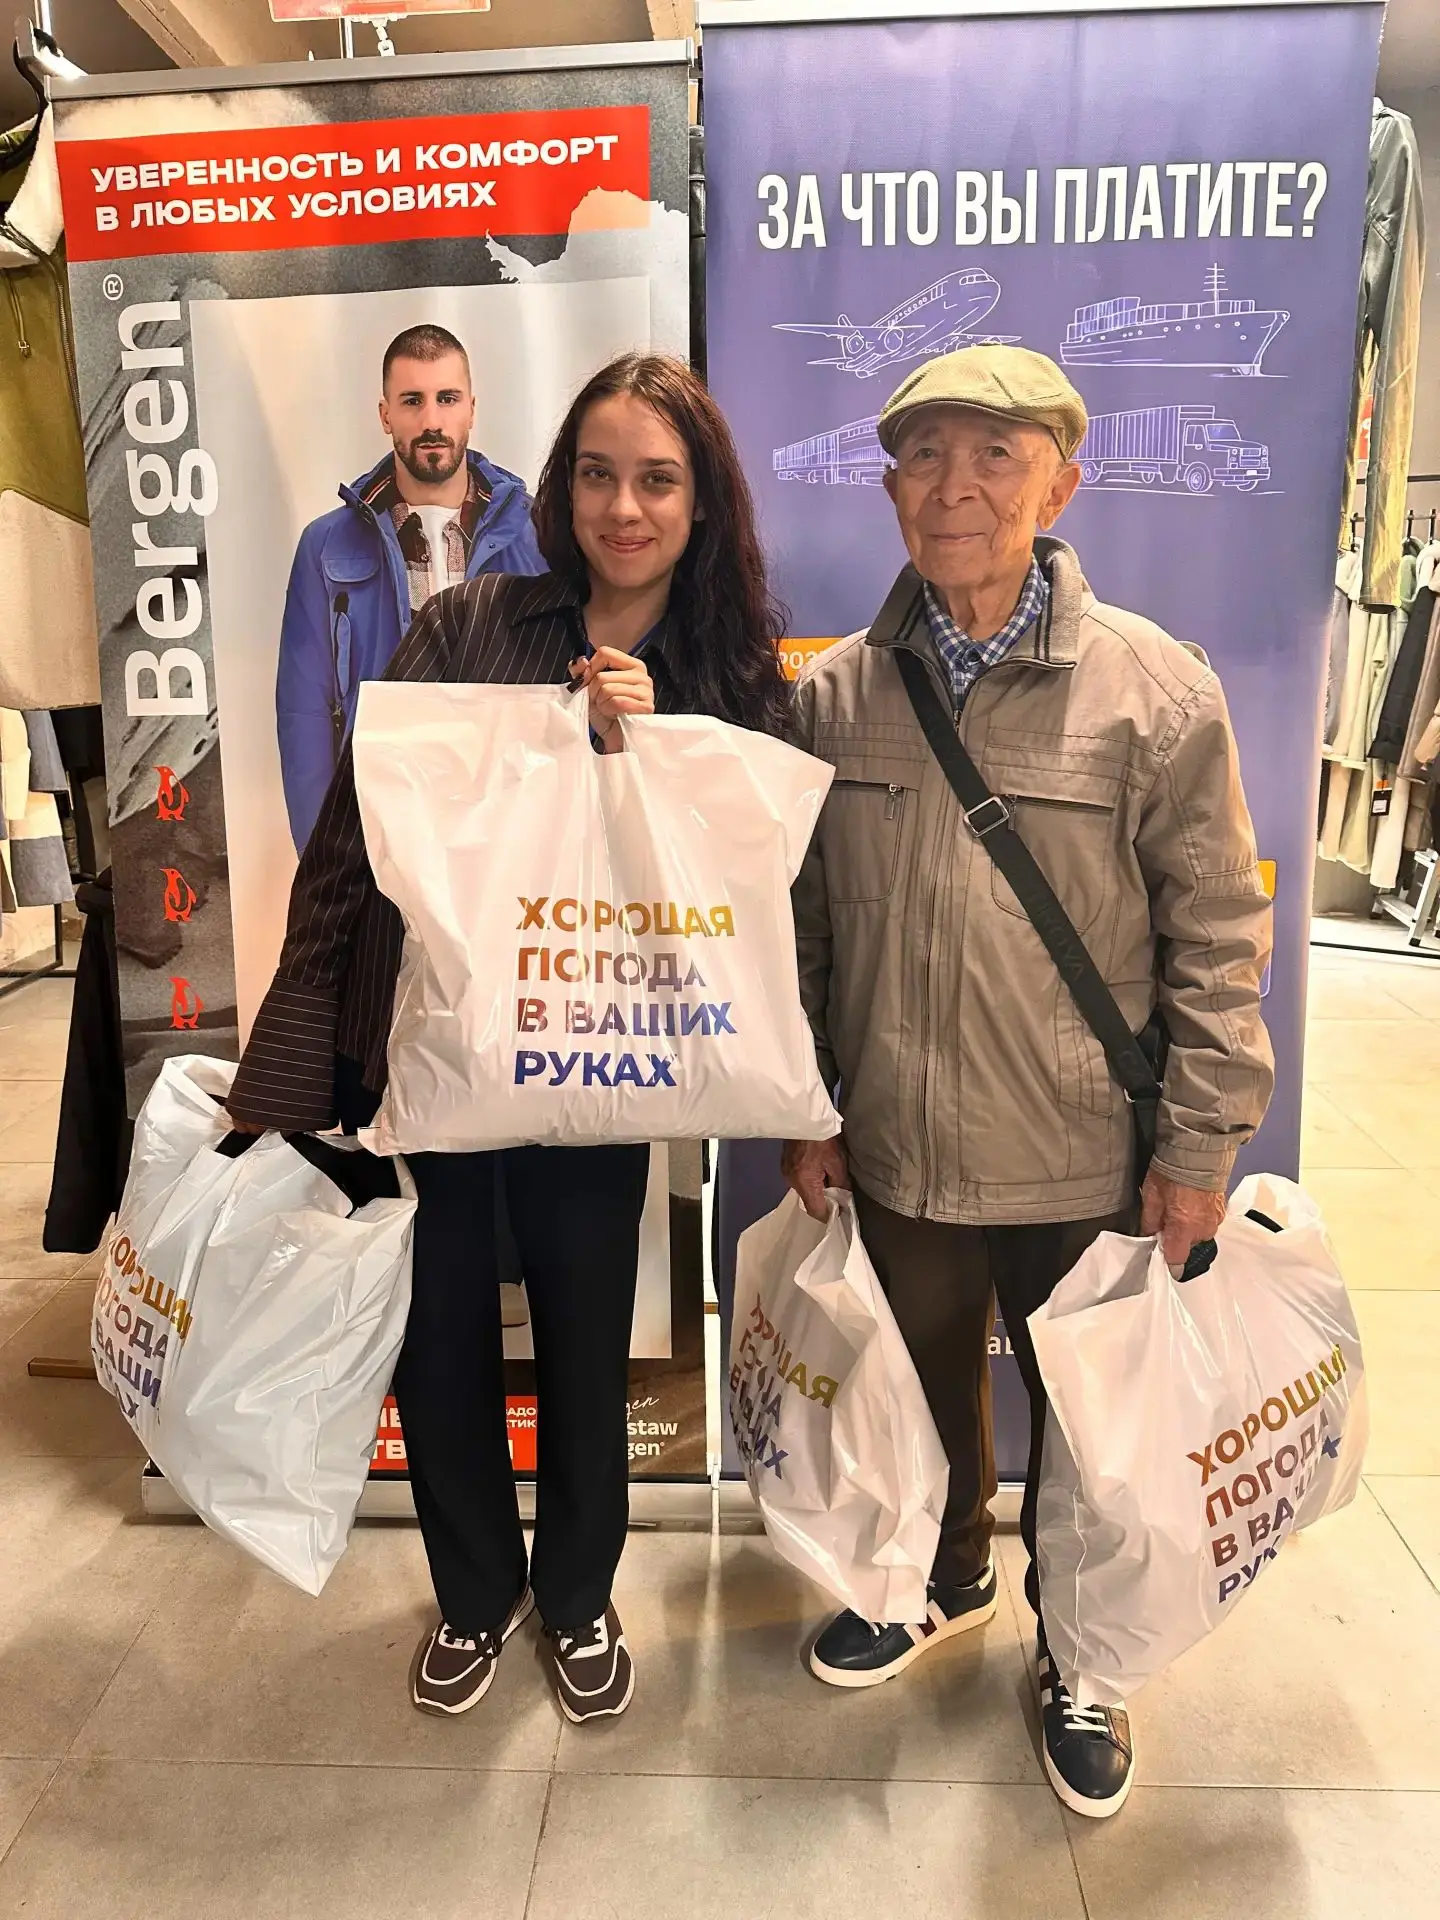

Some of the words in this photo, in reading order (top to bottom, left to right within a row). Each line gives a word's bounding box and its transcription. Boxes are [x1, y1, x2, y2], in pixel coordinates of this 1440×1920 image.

[91, 151, 364, 193] УВЕРЕННОСТЬ
[375, 147, 401, 174] И
[415, 135, 619, 171] КОМФОРТ
[95, 206, 120, 232] В
[130, 195, 276, 229] ЛЮБЫХ
[287, 180, 497, 219] УСЛОВИЯХ
[757, 173, 827, 250] ЗА
[841, 169, 939, 247] ЧТО
[955, 168, 1038, 245] ВЫ
[1053, 161, 1328, 244] ПЛАТИТЕ?
[516, 896, 736, 939] ХОРОШАЯ
[517, 946, 707, 993] ПОГОДА
[517, 998, 549, 1033] В
[565, 1000, 739, 1037] ВАШИХ
[513, 1050, 679, 1088] РУКАХ
[97, 1268, 168, 1359] ОГОДА
[95, 1316, 162, 1409] ВАШИ
[1211, 1533, 1239, 1568] В
